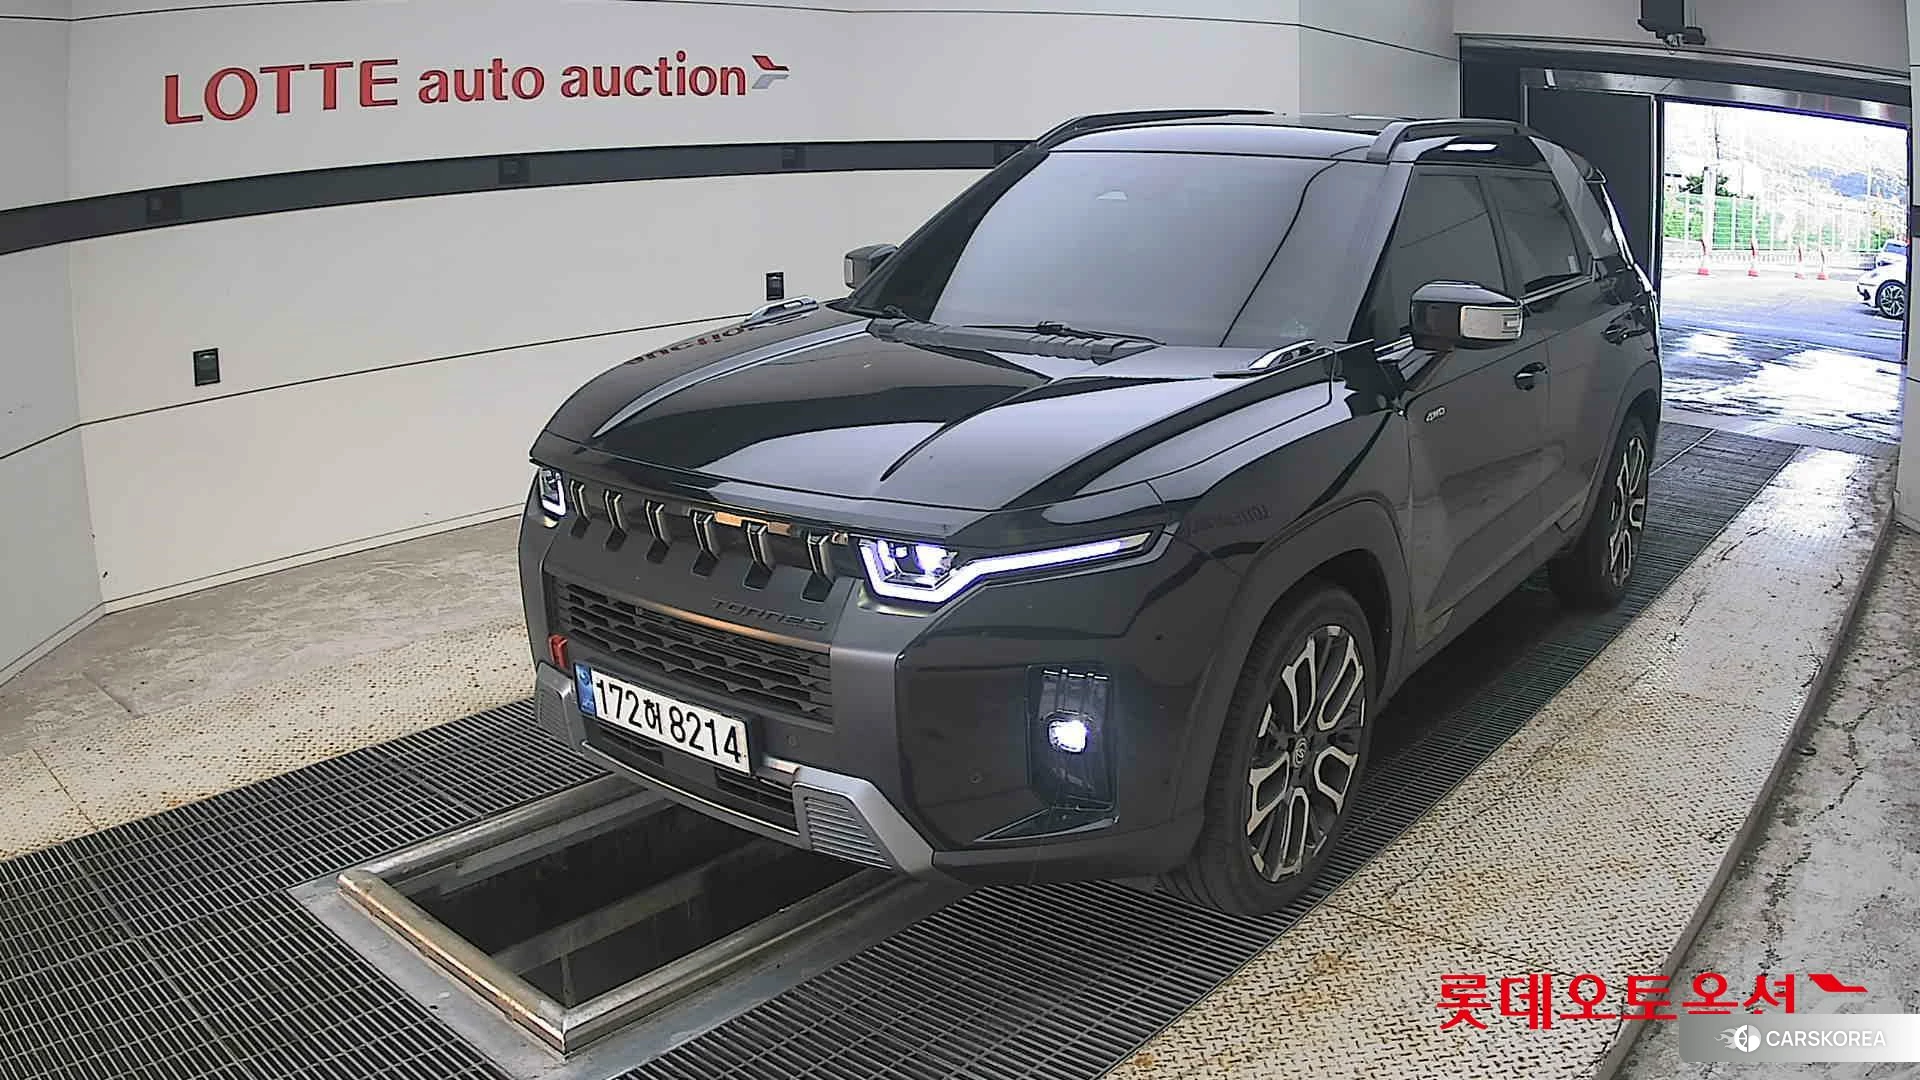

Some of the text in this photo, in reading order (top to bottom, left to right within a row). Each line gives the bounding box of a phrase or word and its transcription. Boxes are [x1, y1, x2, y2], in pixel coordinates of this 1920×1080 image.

[164, 50, 747, 125] LOTTE auto auction
[711, 598, 828, 632] TORRES
[596, 679, 742, 764] 172허 8214
